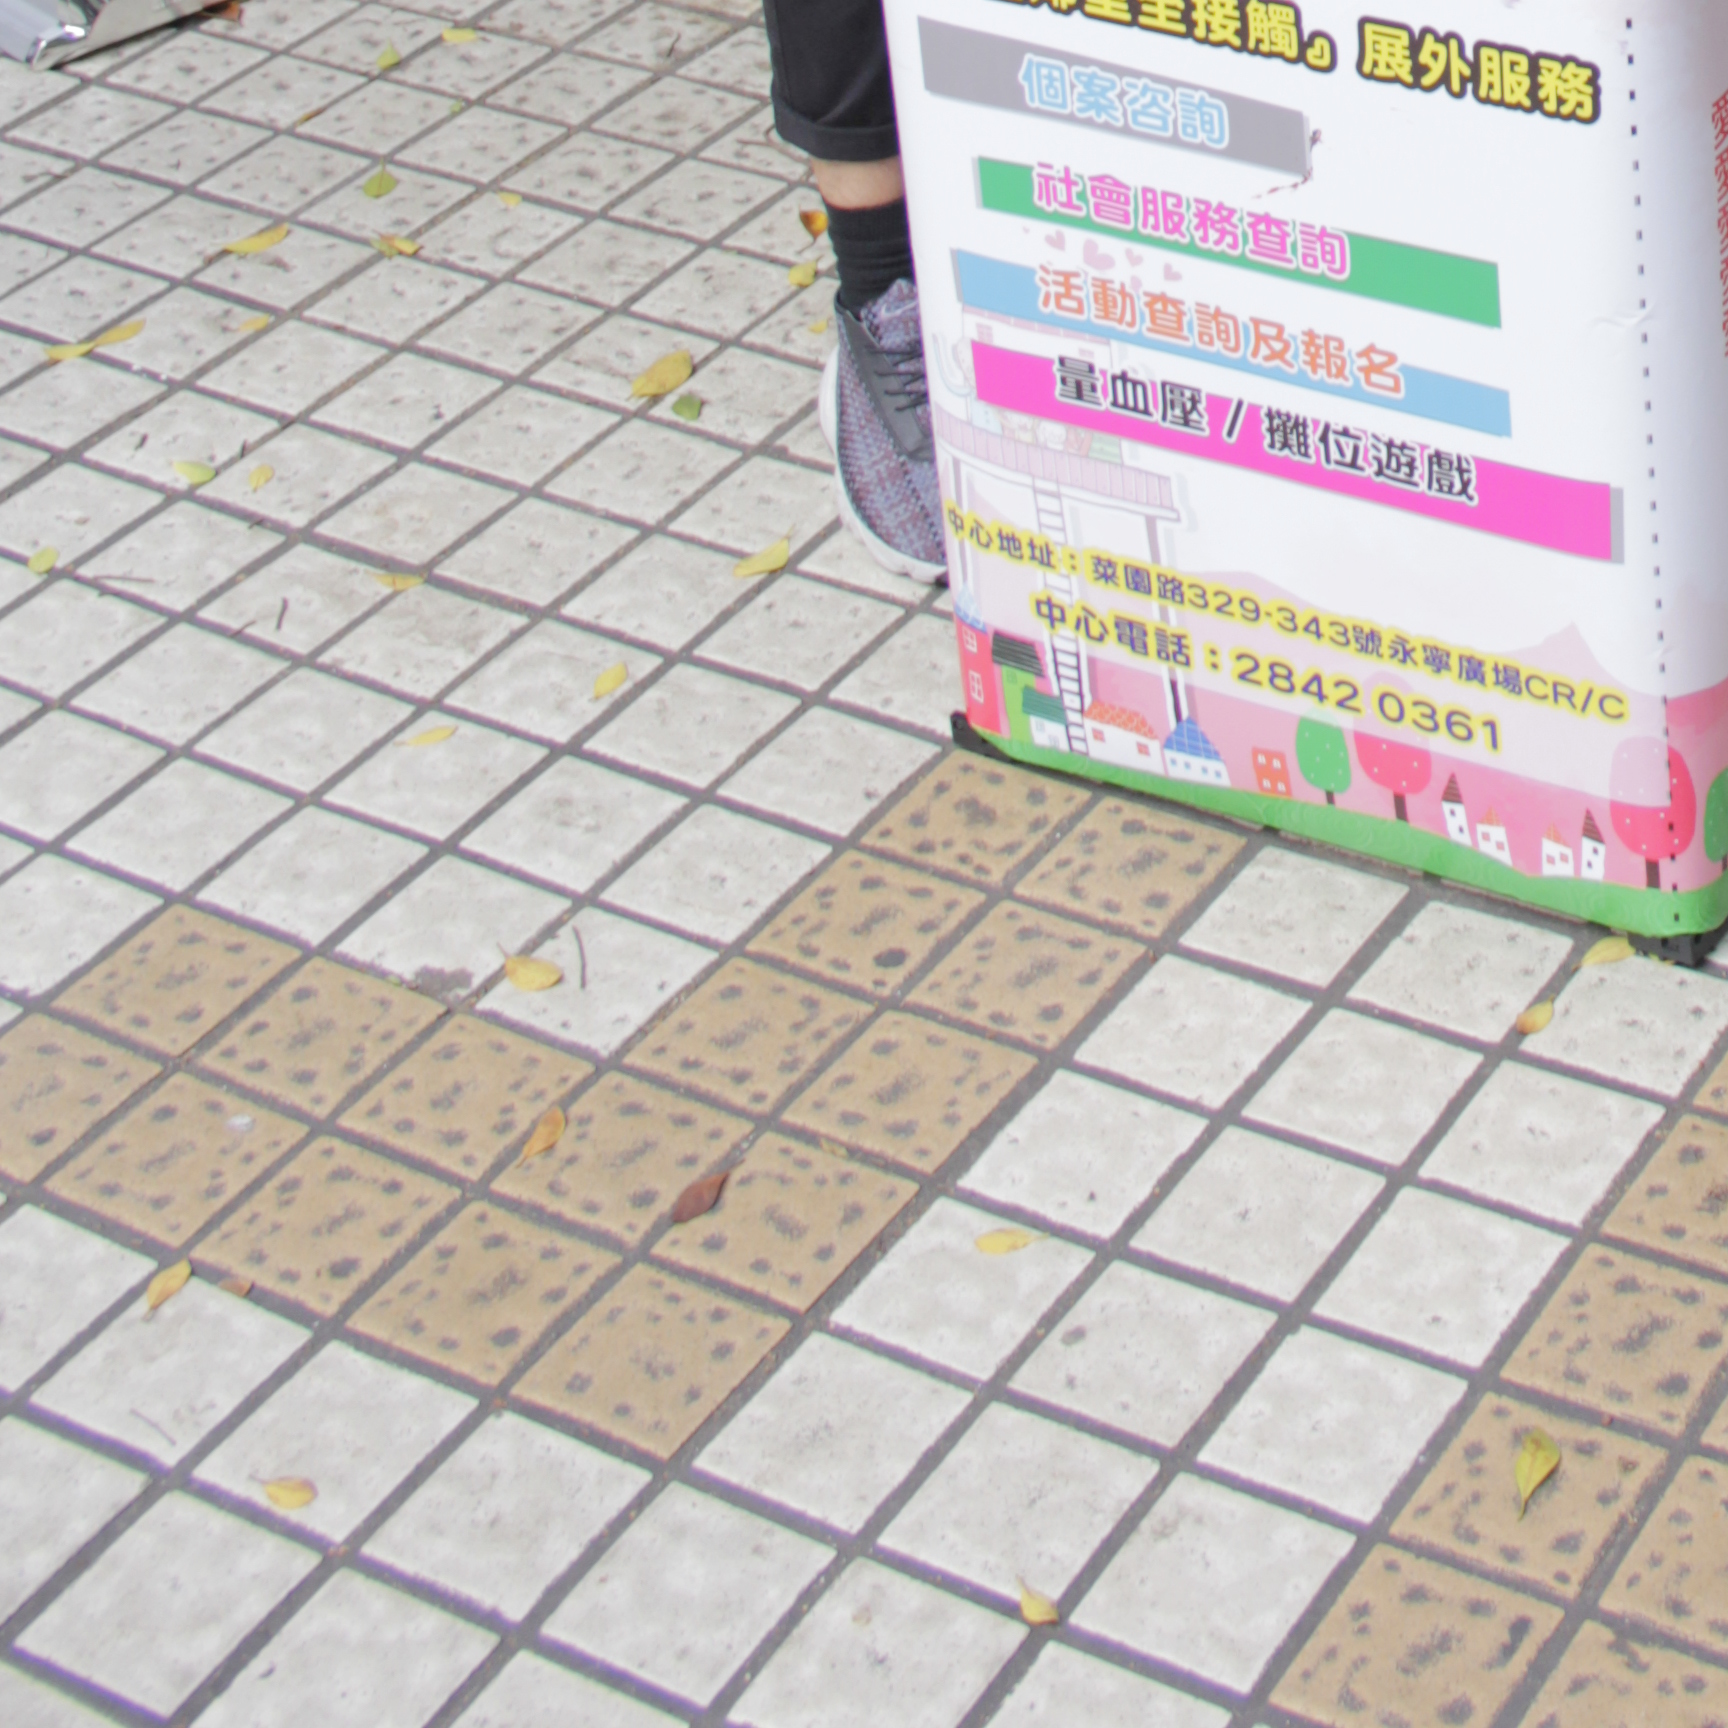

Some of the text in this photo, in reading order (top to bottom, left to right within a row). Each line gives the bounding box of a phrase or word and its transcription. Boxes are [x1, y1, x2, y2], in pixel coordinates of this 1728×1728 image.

[1034, 161, 1349, 277] 社會服務查詢
[1036, 261, 1405, 397] 活動查詢及報名
